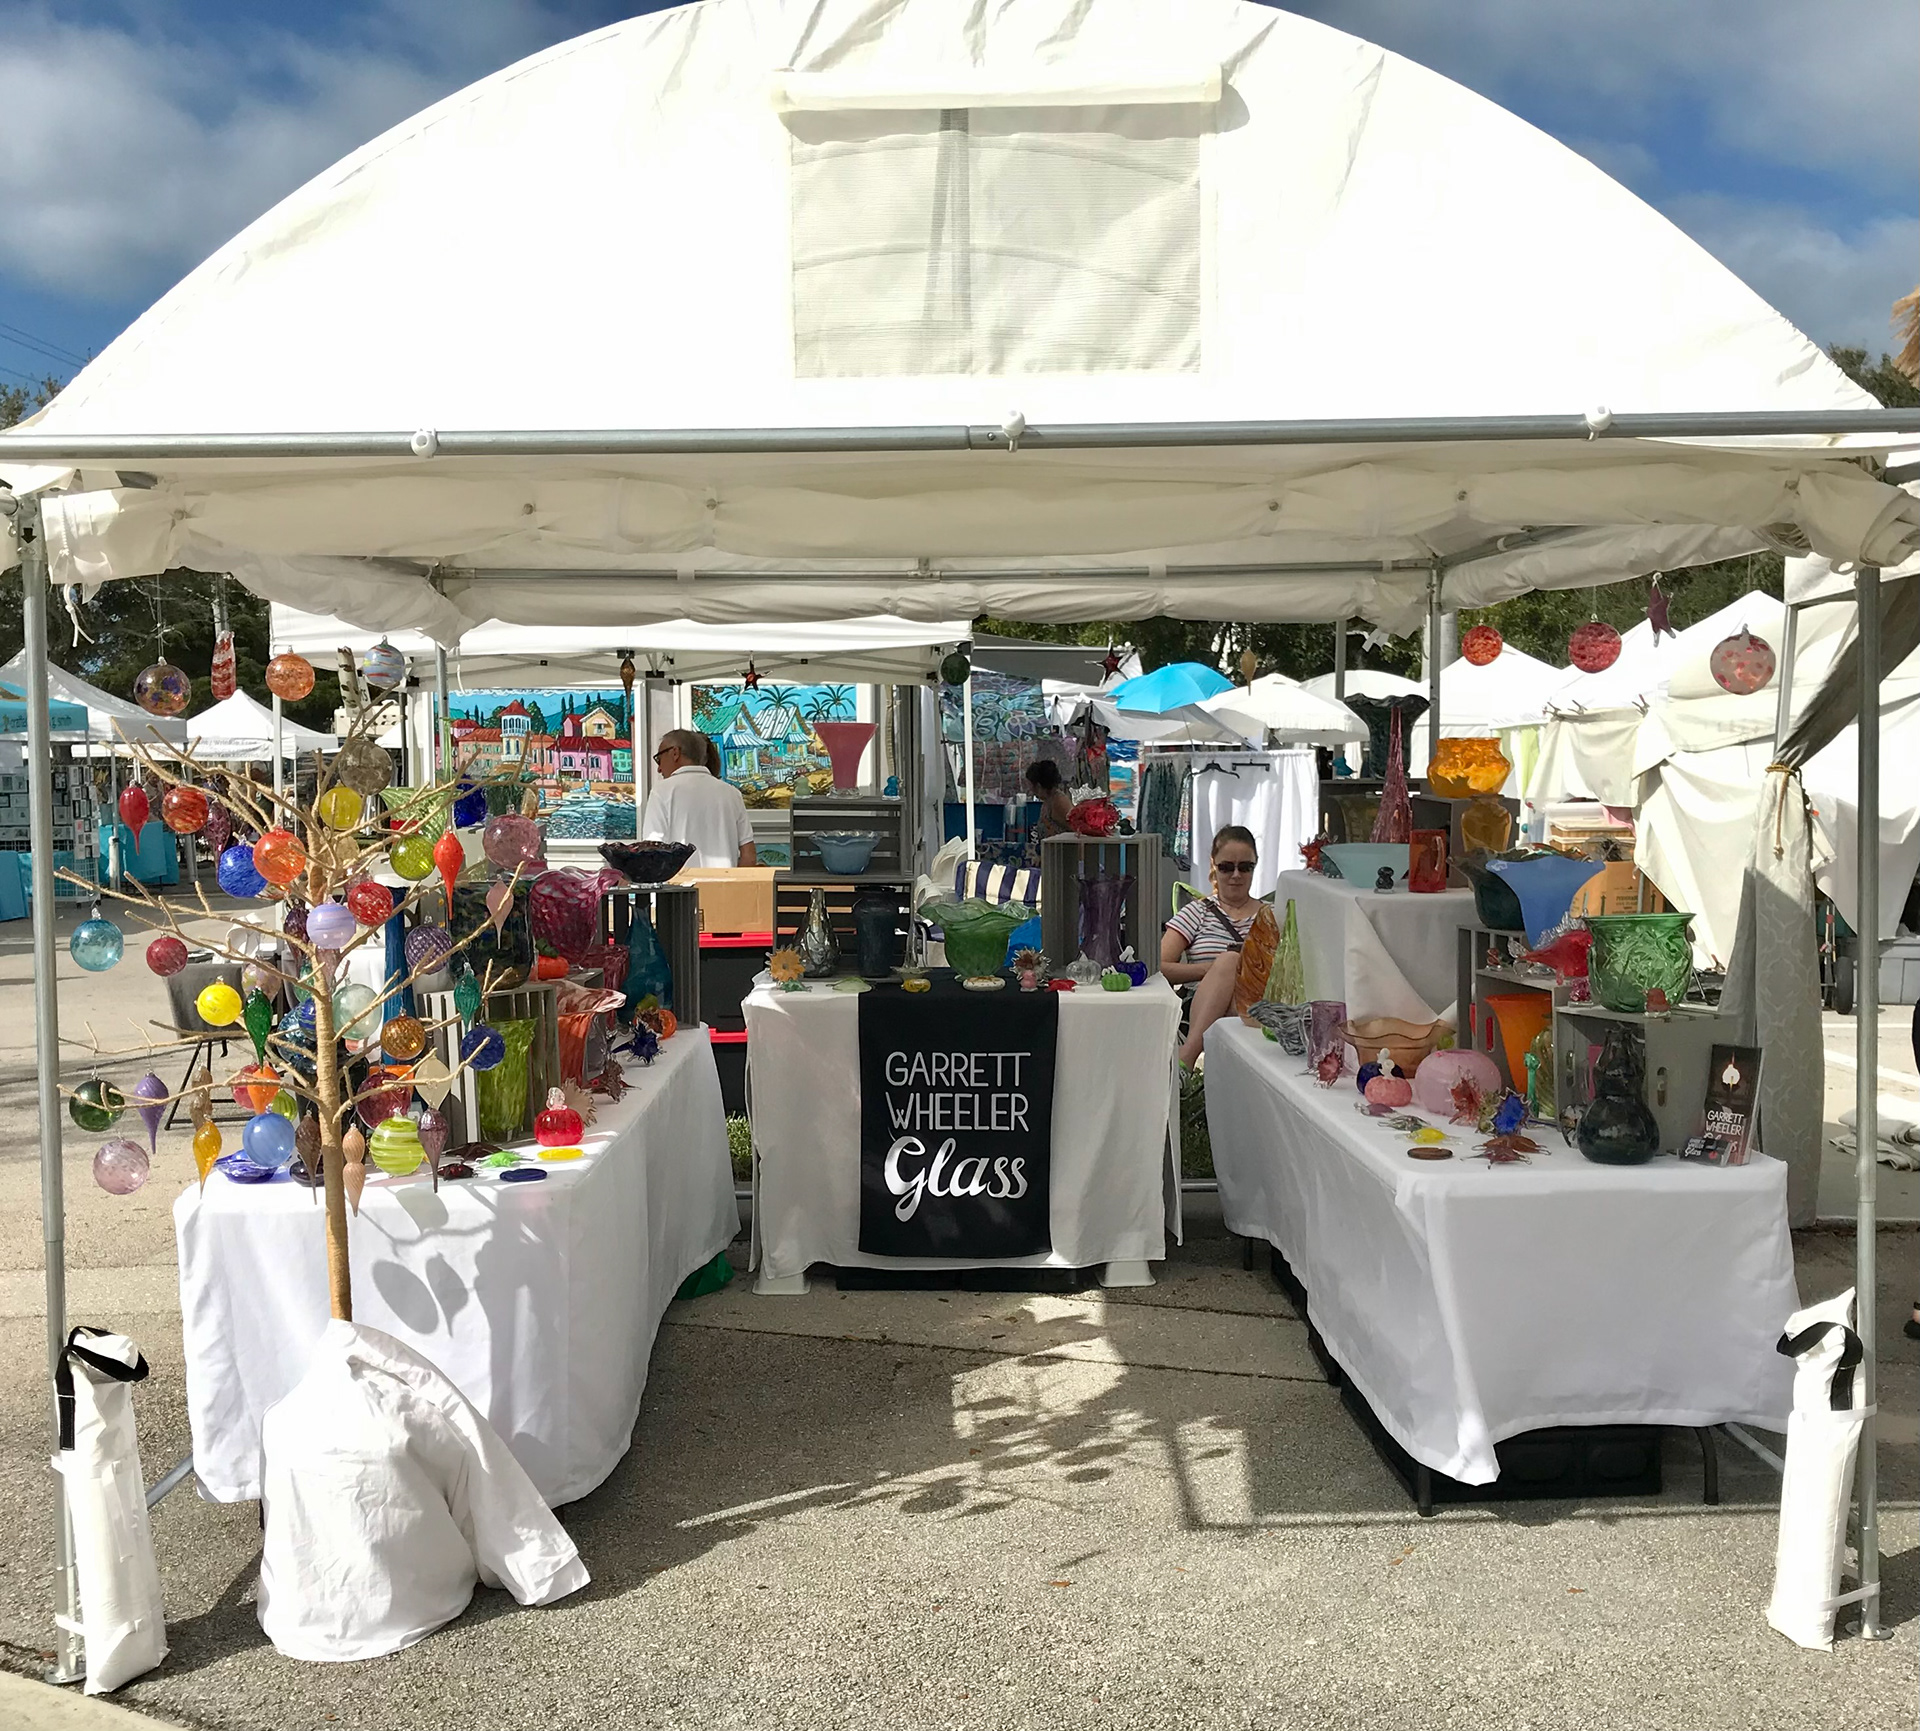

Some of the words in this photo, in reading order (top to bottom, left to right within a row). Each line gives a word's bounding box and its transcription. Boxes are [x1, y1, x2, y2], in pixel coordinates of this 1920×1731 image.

[885, 1051, 1031, 1087] GARRETT
[885, 1091, 1030, 1132] WHEELER
[1705, 1120, 1742, 1136] WHEELER
[1707, 1110, 1744, 1124] GARRETT
[884, 1127, 1028, 1222] Glass
